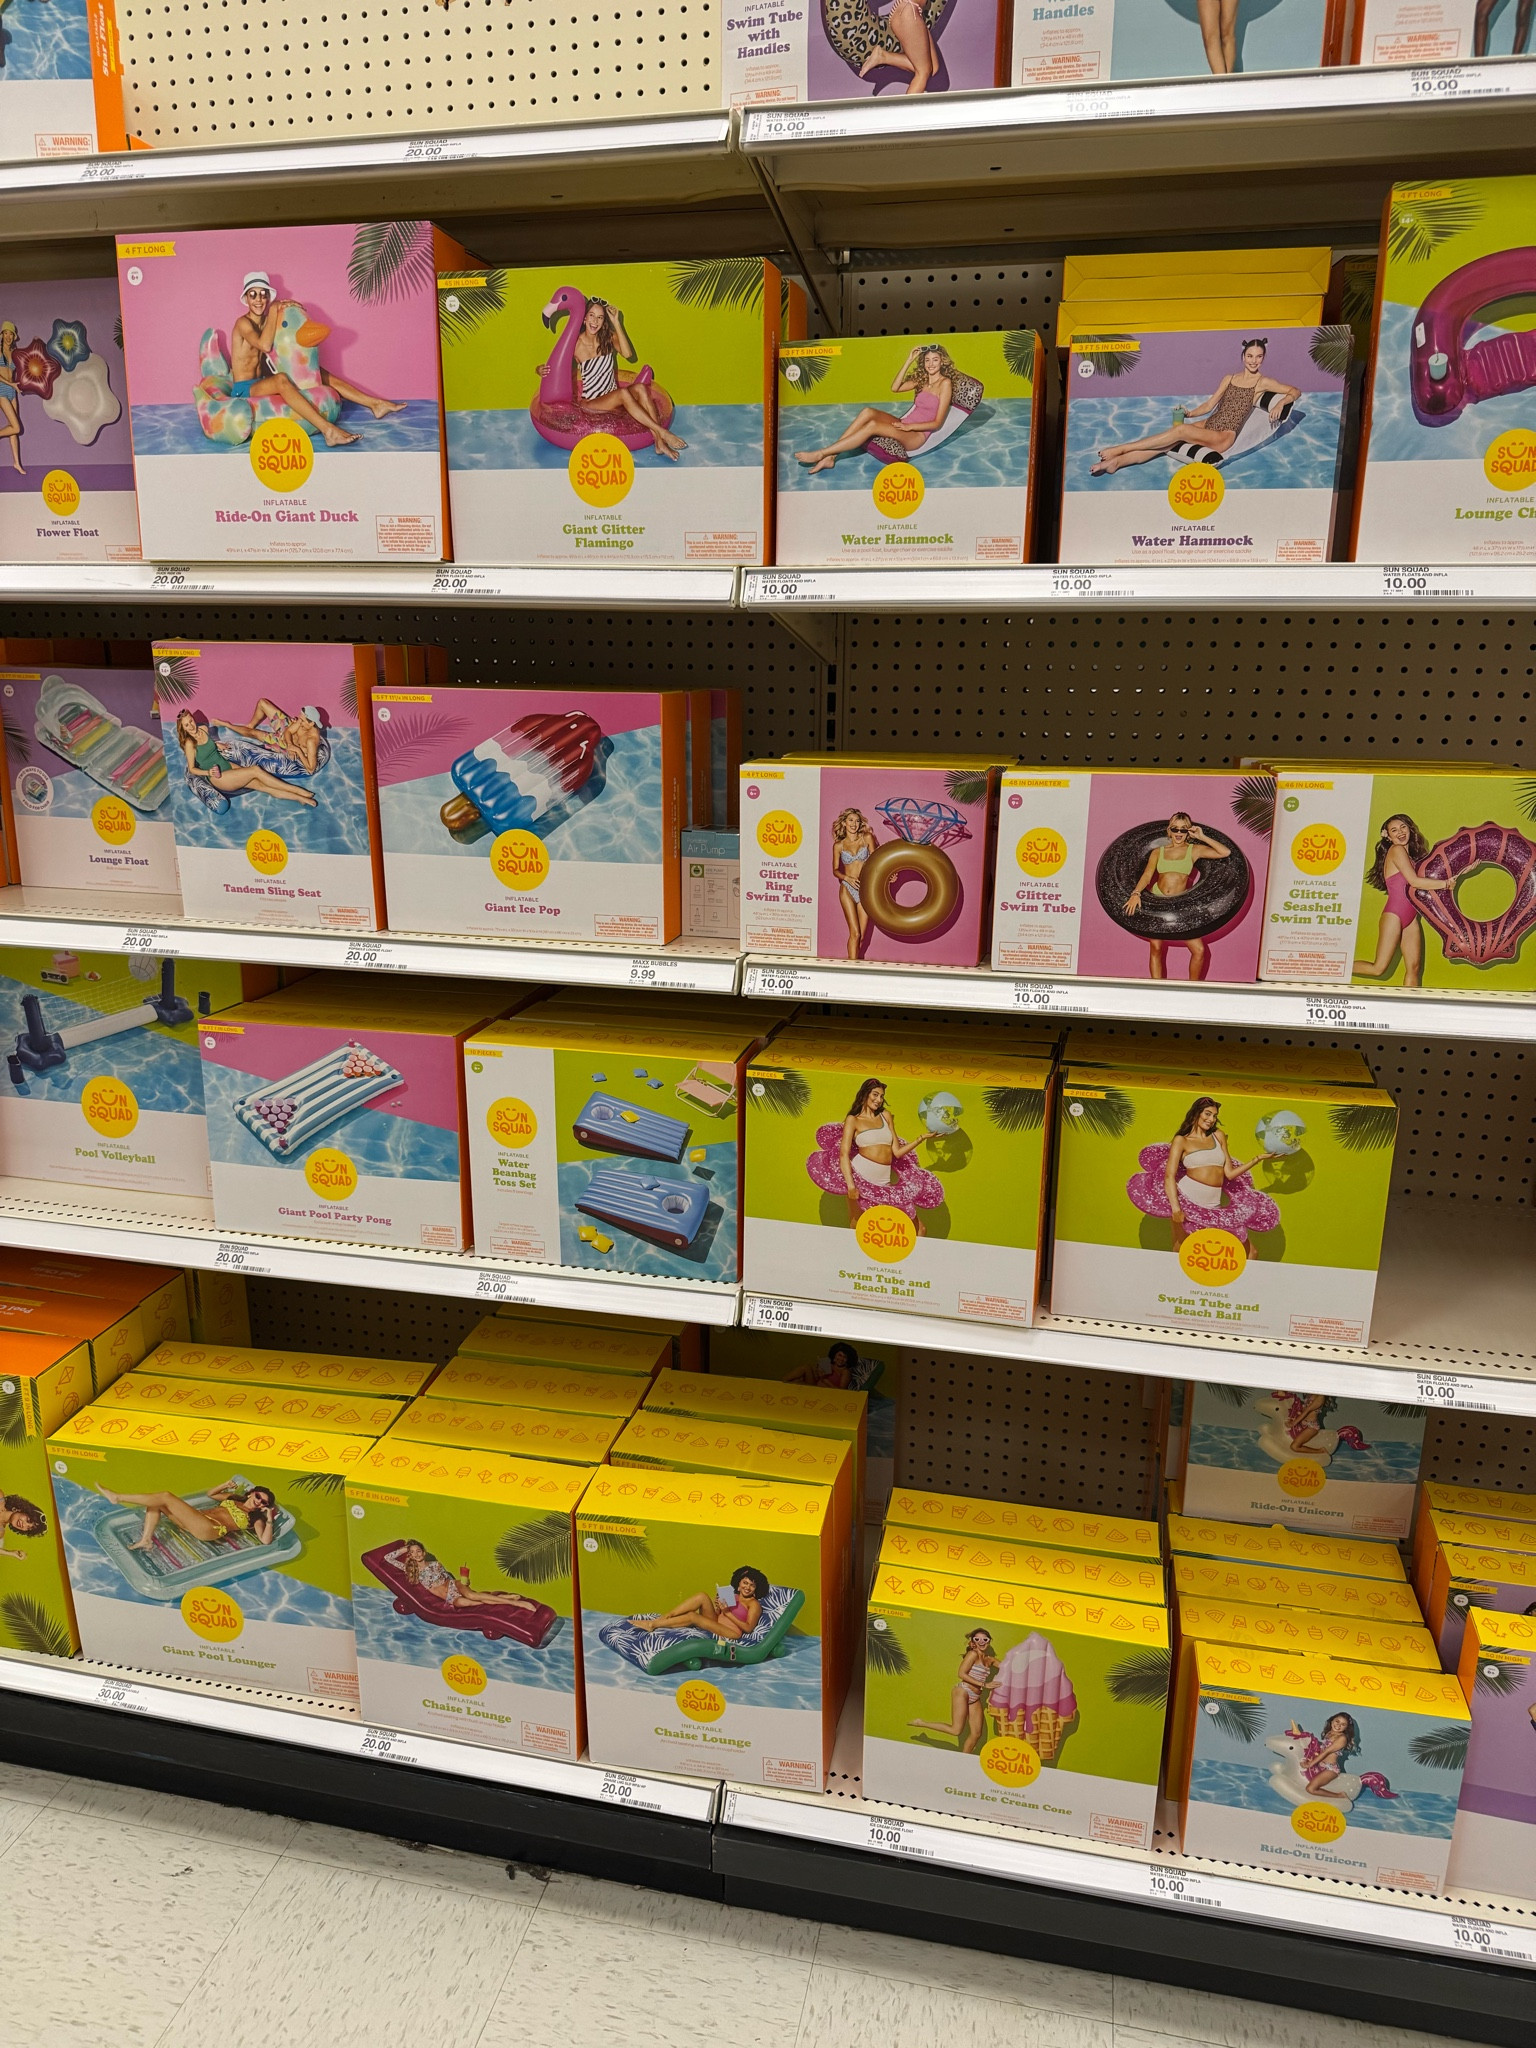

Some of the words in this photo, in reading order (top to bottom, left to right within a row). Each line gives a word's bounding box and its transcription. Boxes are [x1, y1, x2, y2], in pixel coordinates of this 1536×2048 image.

[744, 1, 785, 12] INFLATABLE
[1032, 4, 1094, 21] Handles
[98, 3, 107, 41] Float
[727, 14, 765, 31] Swim
[768, 9, 803, 23] Tube
[748, 28, 780, 42] with
[737, 42, 790, 59] Handles
[1413, 80, 1458, 92] 10.00
[1067, 101, 1108, 112] 10.00
[766, 121, 804, 132] 10.00
[52, 136, 90, 146] WARNING:
[406, 148, 441, 157] 20.00
[125, 246, 131, 255] 4
[132, 246, 142, 254] FT
[144, 245, 165, 254] LONG
[262, 434, 301, 455] SUN
[259, 455, 306, 473] SQUAD
[582, 449, 621, 469] SUN
[577, 472, 627, 489] SQUAD
[883, 474, 915, 489] SUN
[1180, 475, 1214, 490] SUN
[879, 491, 918, 504] SQUAD
[1175, 492, 1217, 505] SQUAD
[215, 510, 272, 523] Ride-On
[275, 510, 316, 523] Giant
[320, 510, 359, 522] Duck
[1455, 508, 1513, 521] Lounge
[37, 528, 70, 538] Flower
[73, 528, 99, 537] Float
[563, 524, 598, 535] Giant
[601, 524, 645, 535] Glitter
[575, 538, 634, 550] Flamingo
[841, 534, 880, 545] Water
[885, 534, 954, 545] Hammock
[1132, 536, 1175, 547] Water
[1179, 536, 1253, 546] Hammock
[154, 576, 184, 584] 20.00
[433, 579, 467, 588] 20.00
[1053, 579, 1091, 590] 10.00
[1384, 578, 1426, 589] 10.00
[762, 584, 797, 594] 10.00
[1303, 834, 1336, 848] SUN
[502, 843, 538, 859] SUN
[687, 844, 699, 854] Air
[701, 845, 725, 856] Pump
[1297, 850, 1339, 862] SQUAD
[90, 855, 122, 866] Lounge
[125, 856, 149, 866] Float
[498, 860, 543, 874] SQUAD
[759, 870, 799, 880] Glitter
[223, 884, 264, 896] Tandem
[267, 886, 295, 898] Sling
[298, 888, 321, 898] Seat
[766, 882, 793, 893] Ring
[1289, 889, 1339, 900] Glitter
[746, 892, 780, 902] Swim
[783, 894, 812, 904] Tube
[1016, 890, 1061, 901] Glitter
[485, 903, 517, 913] Giant
[519, 904, 536, 914] Ice
[539, 905, 560, 916] Pop
[1000, 901, 1040, 912] Swim
[1043, 903, 1076, 913] Tube
[1283, 901, 1342, 912] Seashell
[1270, 913, 1311, 924] Swim
[1314, 915, 1352, 926] Tube
[123, 937, 152, 947] 20.00
[346, 951, 377, 962] 20.00
[631, 969, 656, 979] 9.99
[761, 979, 793, 989] 10.00
[1015, 993, 1050, 1003] 10.00
[1307, 1009, 1346, 1019] 10.00
[92, 1088, 127, 1107] SUN
[89, 1106, 133, 1123] SQUAD
[496, 1107, 527, 1122] SUN
[493, 1122, 532, 1135] SQUAD
[75, 1147, 98, 1159] Pool
[101, 1149, 155, 1165] Volleyball
[315, 1159, 347, 1173] SUN
[498, 1158, 529, 1169] Water
[312, 1172, 352, 1187] SQUAD
[492, 1168, 536, 1180] Beanbag
[493, 1177, 516, 1187] Toss
[519, 1179, 536, 1189] Set
[278, 1206, 306, 1217] Giant
[309, 1208, 331, 1219] Pool
[334, 1211, 363, 1224] Party
[365, 1214, 391, 1227] Pong
[868, 1217, 905, 1233] SUN
[863, 1232, 909, 1247] SQUAD
[1193, 1240, 1234, 1257] SUN
[216, 1252, 244, 1264] 20.00
[1187, 1255, 1238, 1271] SQUAD
[839, 1269, 872, 1281] Swim
[875, 1274, 905, 1285] Tube
[907, 1278, 930, 1288] and
[477, 1281, 506, 1293] 20.00
[853, 1281, 888, 1294] Beach
[891, 1285, 915, 1297] Ball
[1158, 1293, 1196, 1306] Swim
[1199, 1298, 1231, 1309] Tube
[1235, 1301, 1259, 1312] and
[759, 1309, 789, 1321] 10.00
[1174, 1305, 1212, 1318] Beach
[1215, 1308, 1241, 1321] Ball
[1417, 1385, 1454, 1399] 10.00
[1250, 1501, 1295, 1513] Ride-On
[1298, 1506, 1344, 1518] Unicorn
[192, 1598, 231, 1617] SUN
[189, 1611, 237, 1630] SQUAD
[162, 1644, 195, 1658] Giant
[198, 1650, 224, 1662] Pool
[227, 1654, 277, 1670] Lounger
[450, 1662, 478, 1679] SUN
[448, 1670, 482, 1687] SQUAD
[98, 1688, 125, 1701] 30.00
[685, 1688, 716, 1702] SUN
[422, 1698, 464, 1714] Chaise
[466, 1706, 511, 1724] Lounge
[682, 1698, 720, 1712] SQUAD
[361, 1737, 391, 1752] 20.00
[654, 1727, 699, 1741] Chaise
[703, 1733, 751, 1749] Lounge
[992, 1746, 1030, 1765] SUN
[779, 1761, 814, 1770] WARNING:
[987, 1758, 1033, 1776] SQUAD
[602, 1782, 632, 1797] 20.00
[944, 1786, 977, 1800] Giant
[980, 1792, 998, 1804] Ice
[1000, 1795, 1039, 1810] Cream
[1042, 1802, 1072, 1816] Cone
[1108, 1816, 1145, 1829] WARNING:
[1303, 1810, 1336, 1825] SUN
[1297, 1819, 1339, 1834] SQUAD
[869, 1829, 901, 1843] 10.00
[1260, 1844, 1311, 1860] Ride-On
[1315, 1852, 1367, 1869] Unicorn
[1150, 1878, 1184, 1893] 10.00
[1454, 1929, 1490, 1945] 10.00
